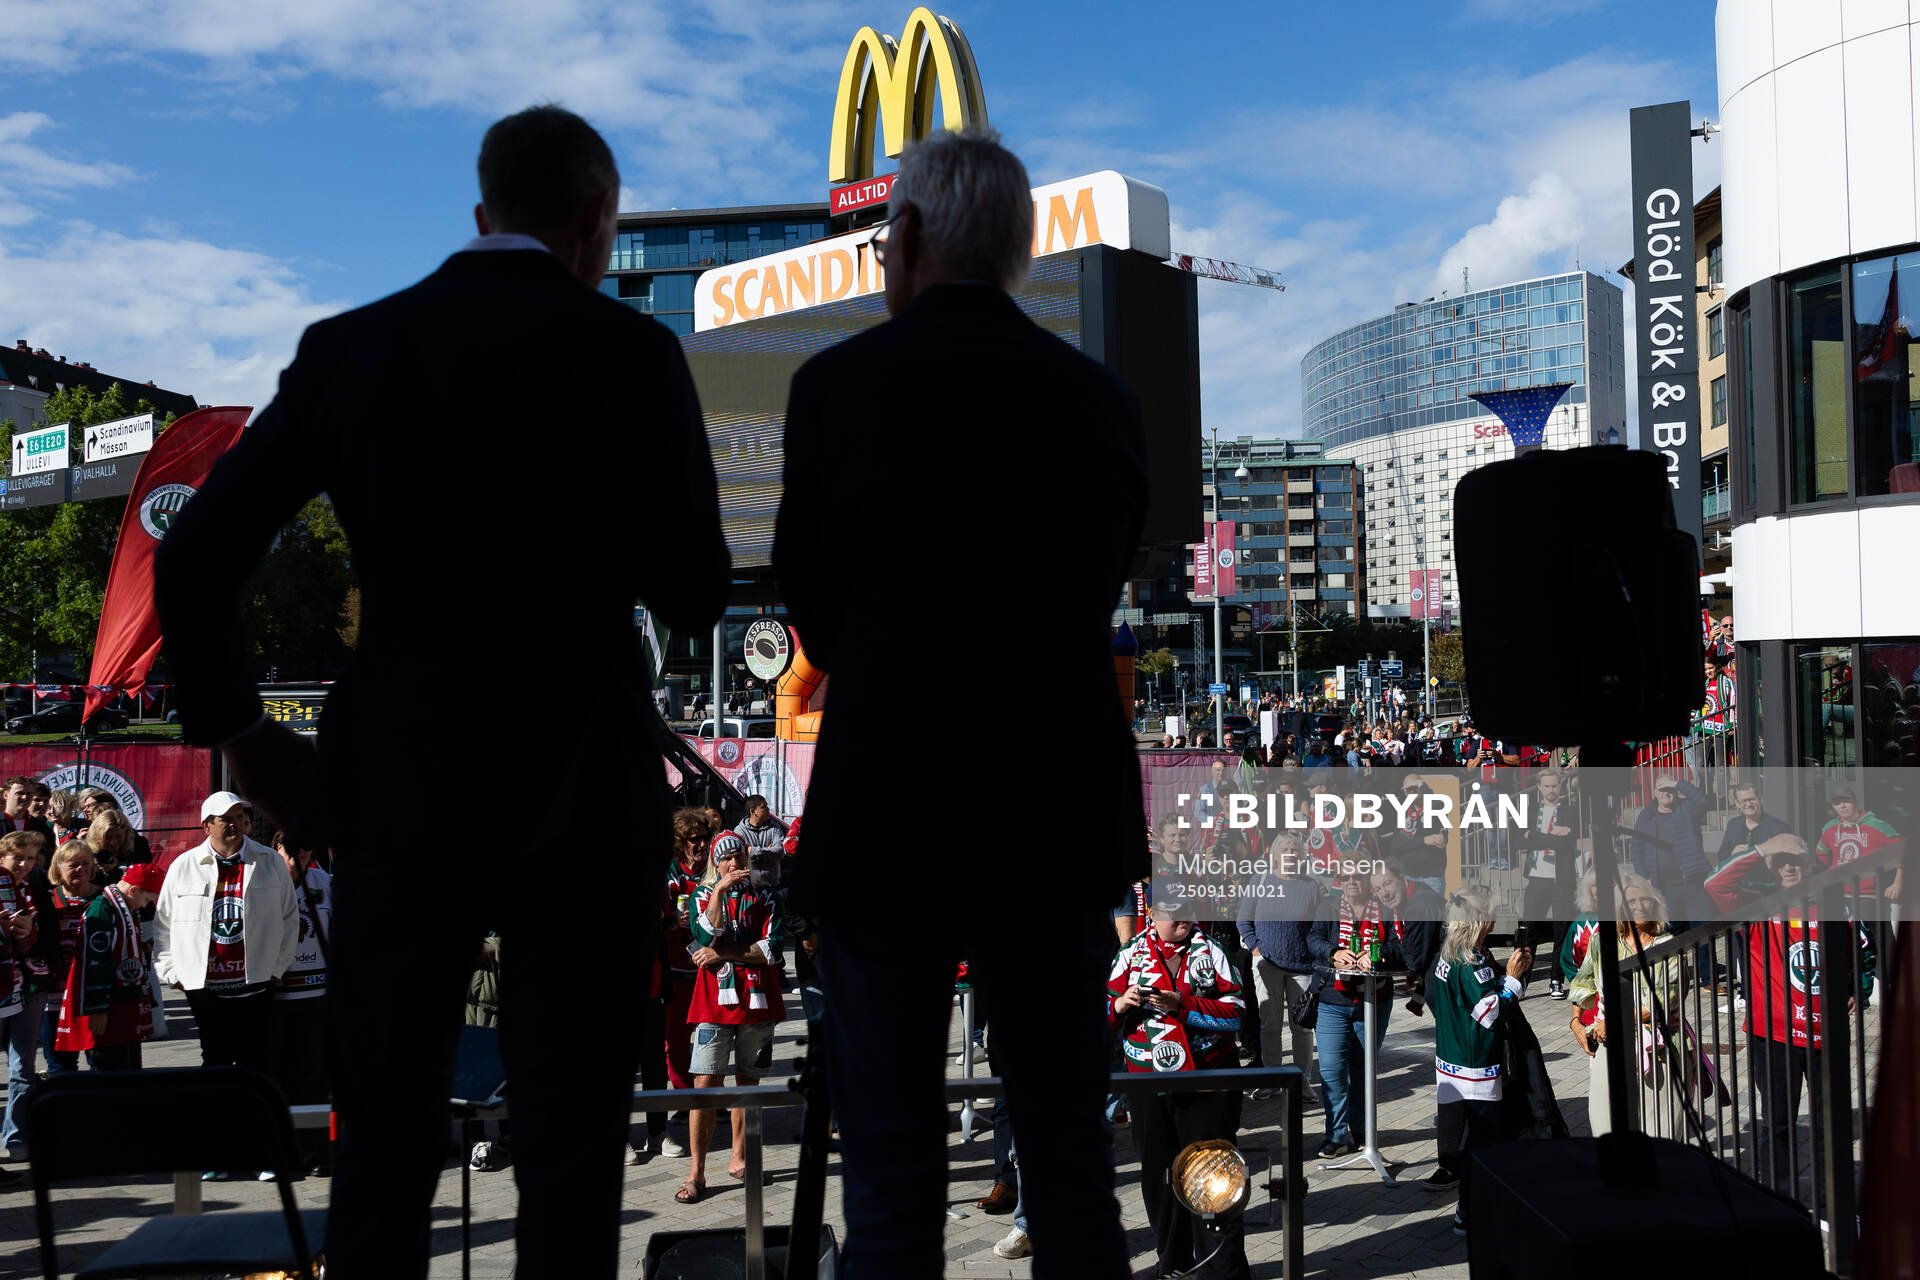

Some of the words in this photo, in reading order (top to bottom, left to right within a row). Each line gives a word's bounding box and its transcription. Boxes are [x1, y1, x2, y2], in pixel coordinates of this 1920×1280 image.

[838, 182, 887, 208] ALLTID
[1646, 187, 1682, 282] Glöd
[1649, 295, 1686, 371] Kök
[1652, 381, 1686, 409] &
[100, 419, 151, 438] Scandinavium
[29, 440, 39, 452] E6
[46, 435, 62, 446] E20
[100, 440, 128, 455] Mässan
[26, 456, 51, 470] ULLEVI
[83, 464, 117, 481] VALHALLA
[8, 472, 56, 491] ULLEVIGARAGET
[748, 621, 784, 642] ESPRESSO
[1437, 1058, 1462, 1074] SKF
